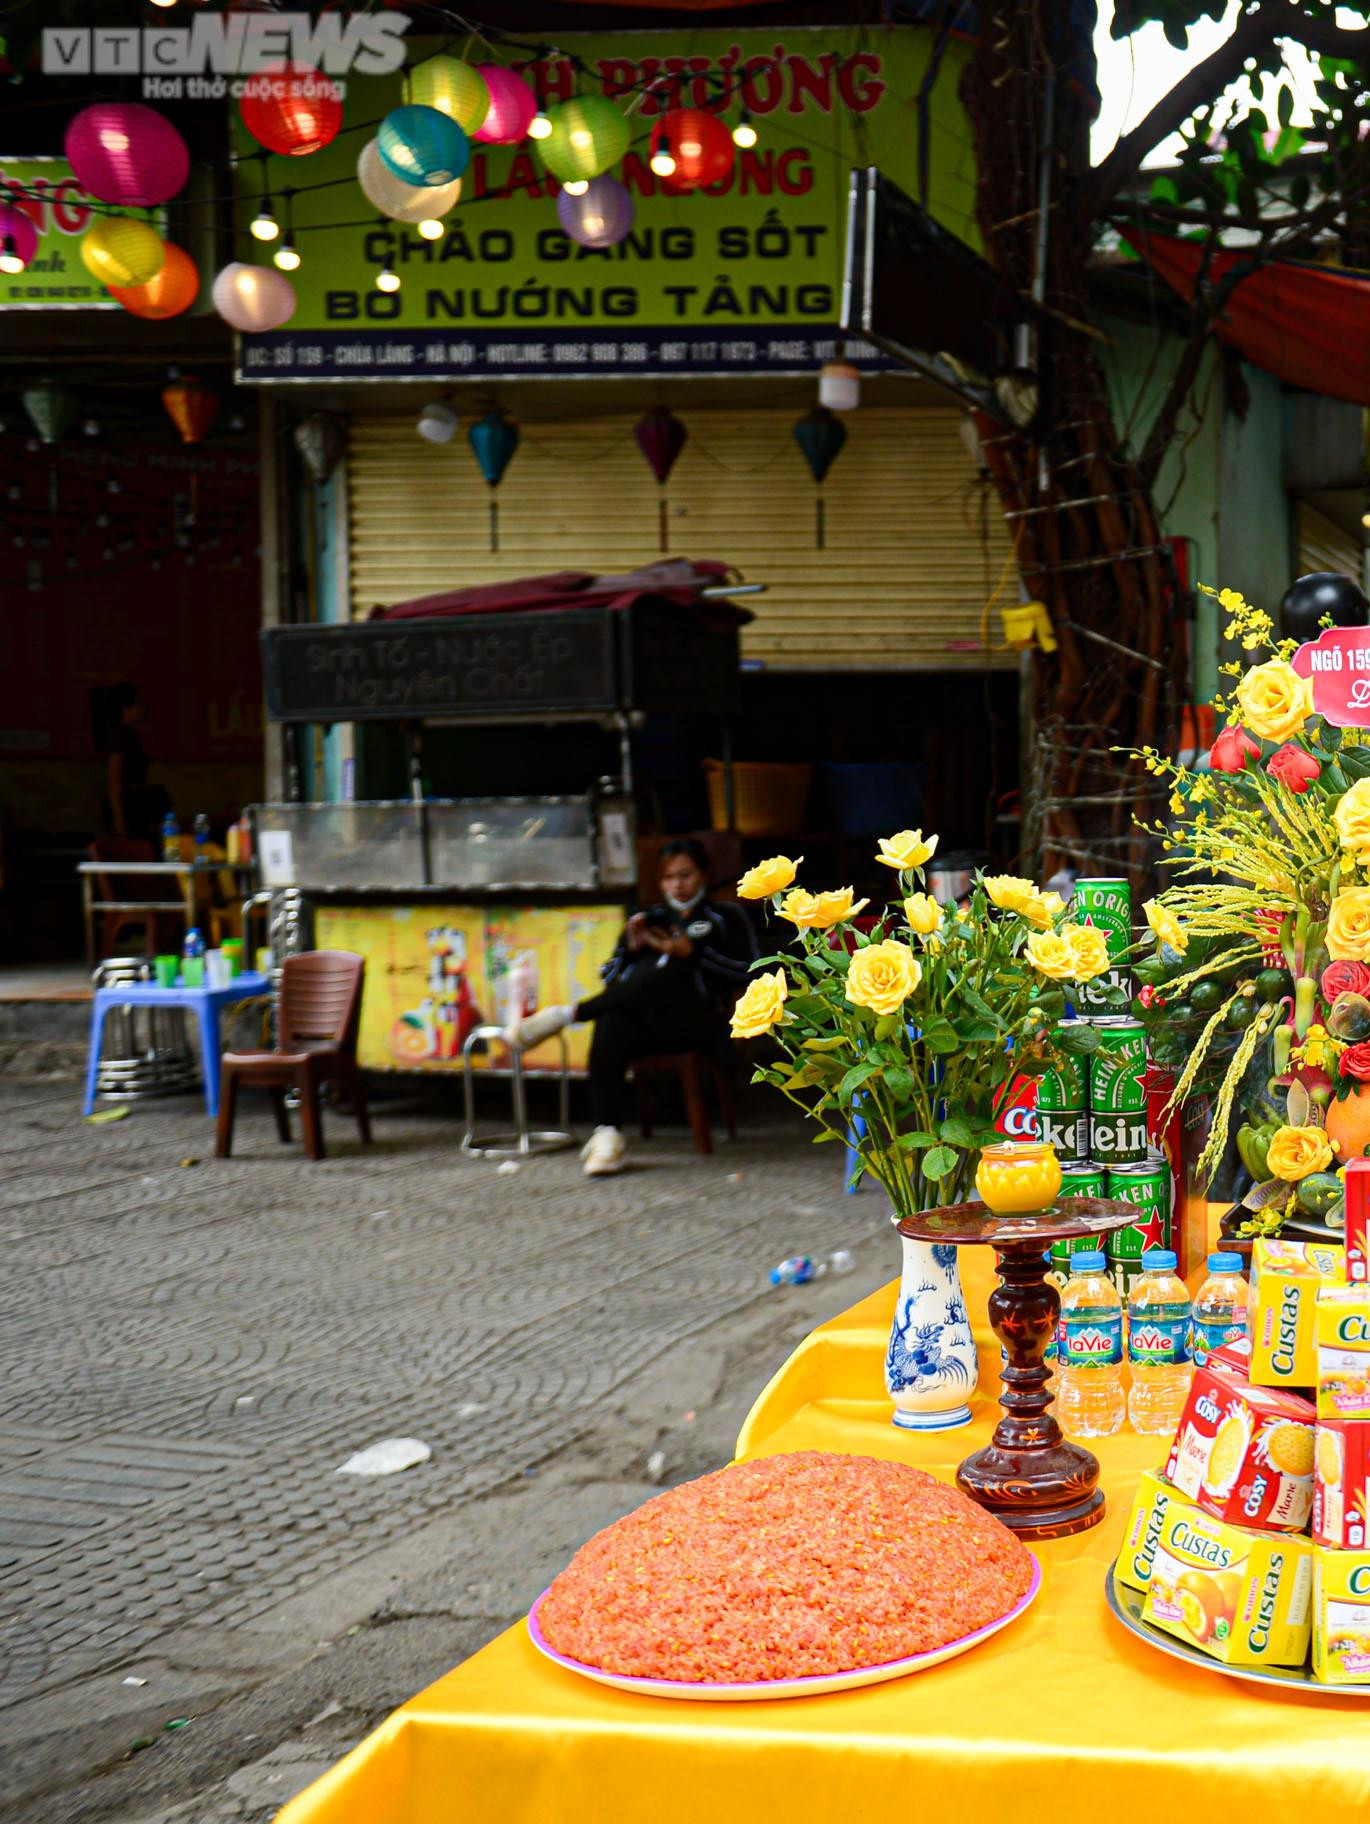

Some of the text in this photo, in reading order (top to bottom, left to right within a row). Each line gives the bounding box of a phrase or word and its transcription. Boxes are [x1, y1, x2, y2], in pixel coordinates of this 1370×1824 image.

[718, 209, 828, 261] SỐT
[427, 277, 638, 319] NƯỚNG
[663, 275, 833, 317] TẢNG
[1311, 645, 1343, 672] NGÕ
[1271, 1285, 1300, 1376] Custas
[1195, 1395, 1222, 1424] COSY
[1243, 1474, 1268, 1517] COSY
[1276, 1482, 1297, 1519] Marie
[1133, 1492, 1169, 1581] Custas
[1170, 1521, 1233, 1569] Custas
[1248, 1552, 1284, 1654] Custas
